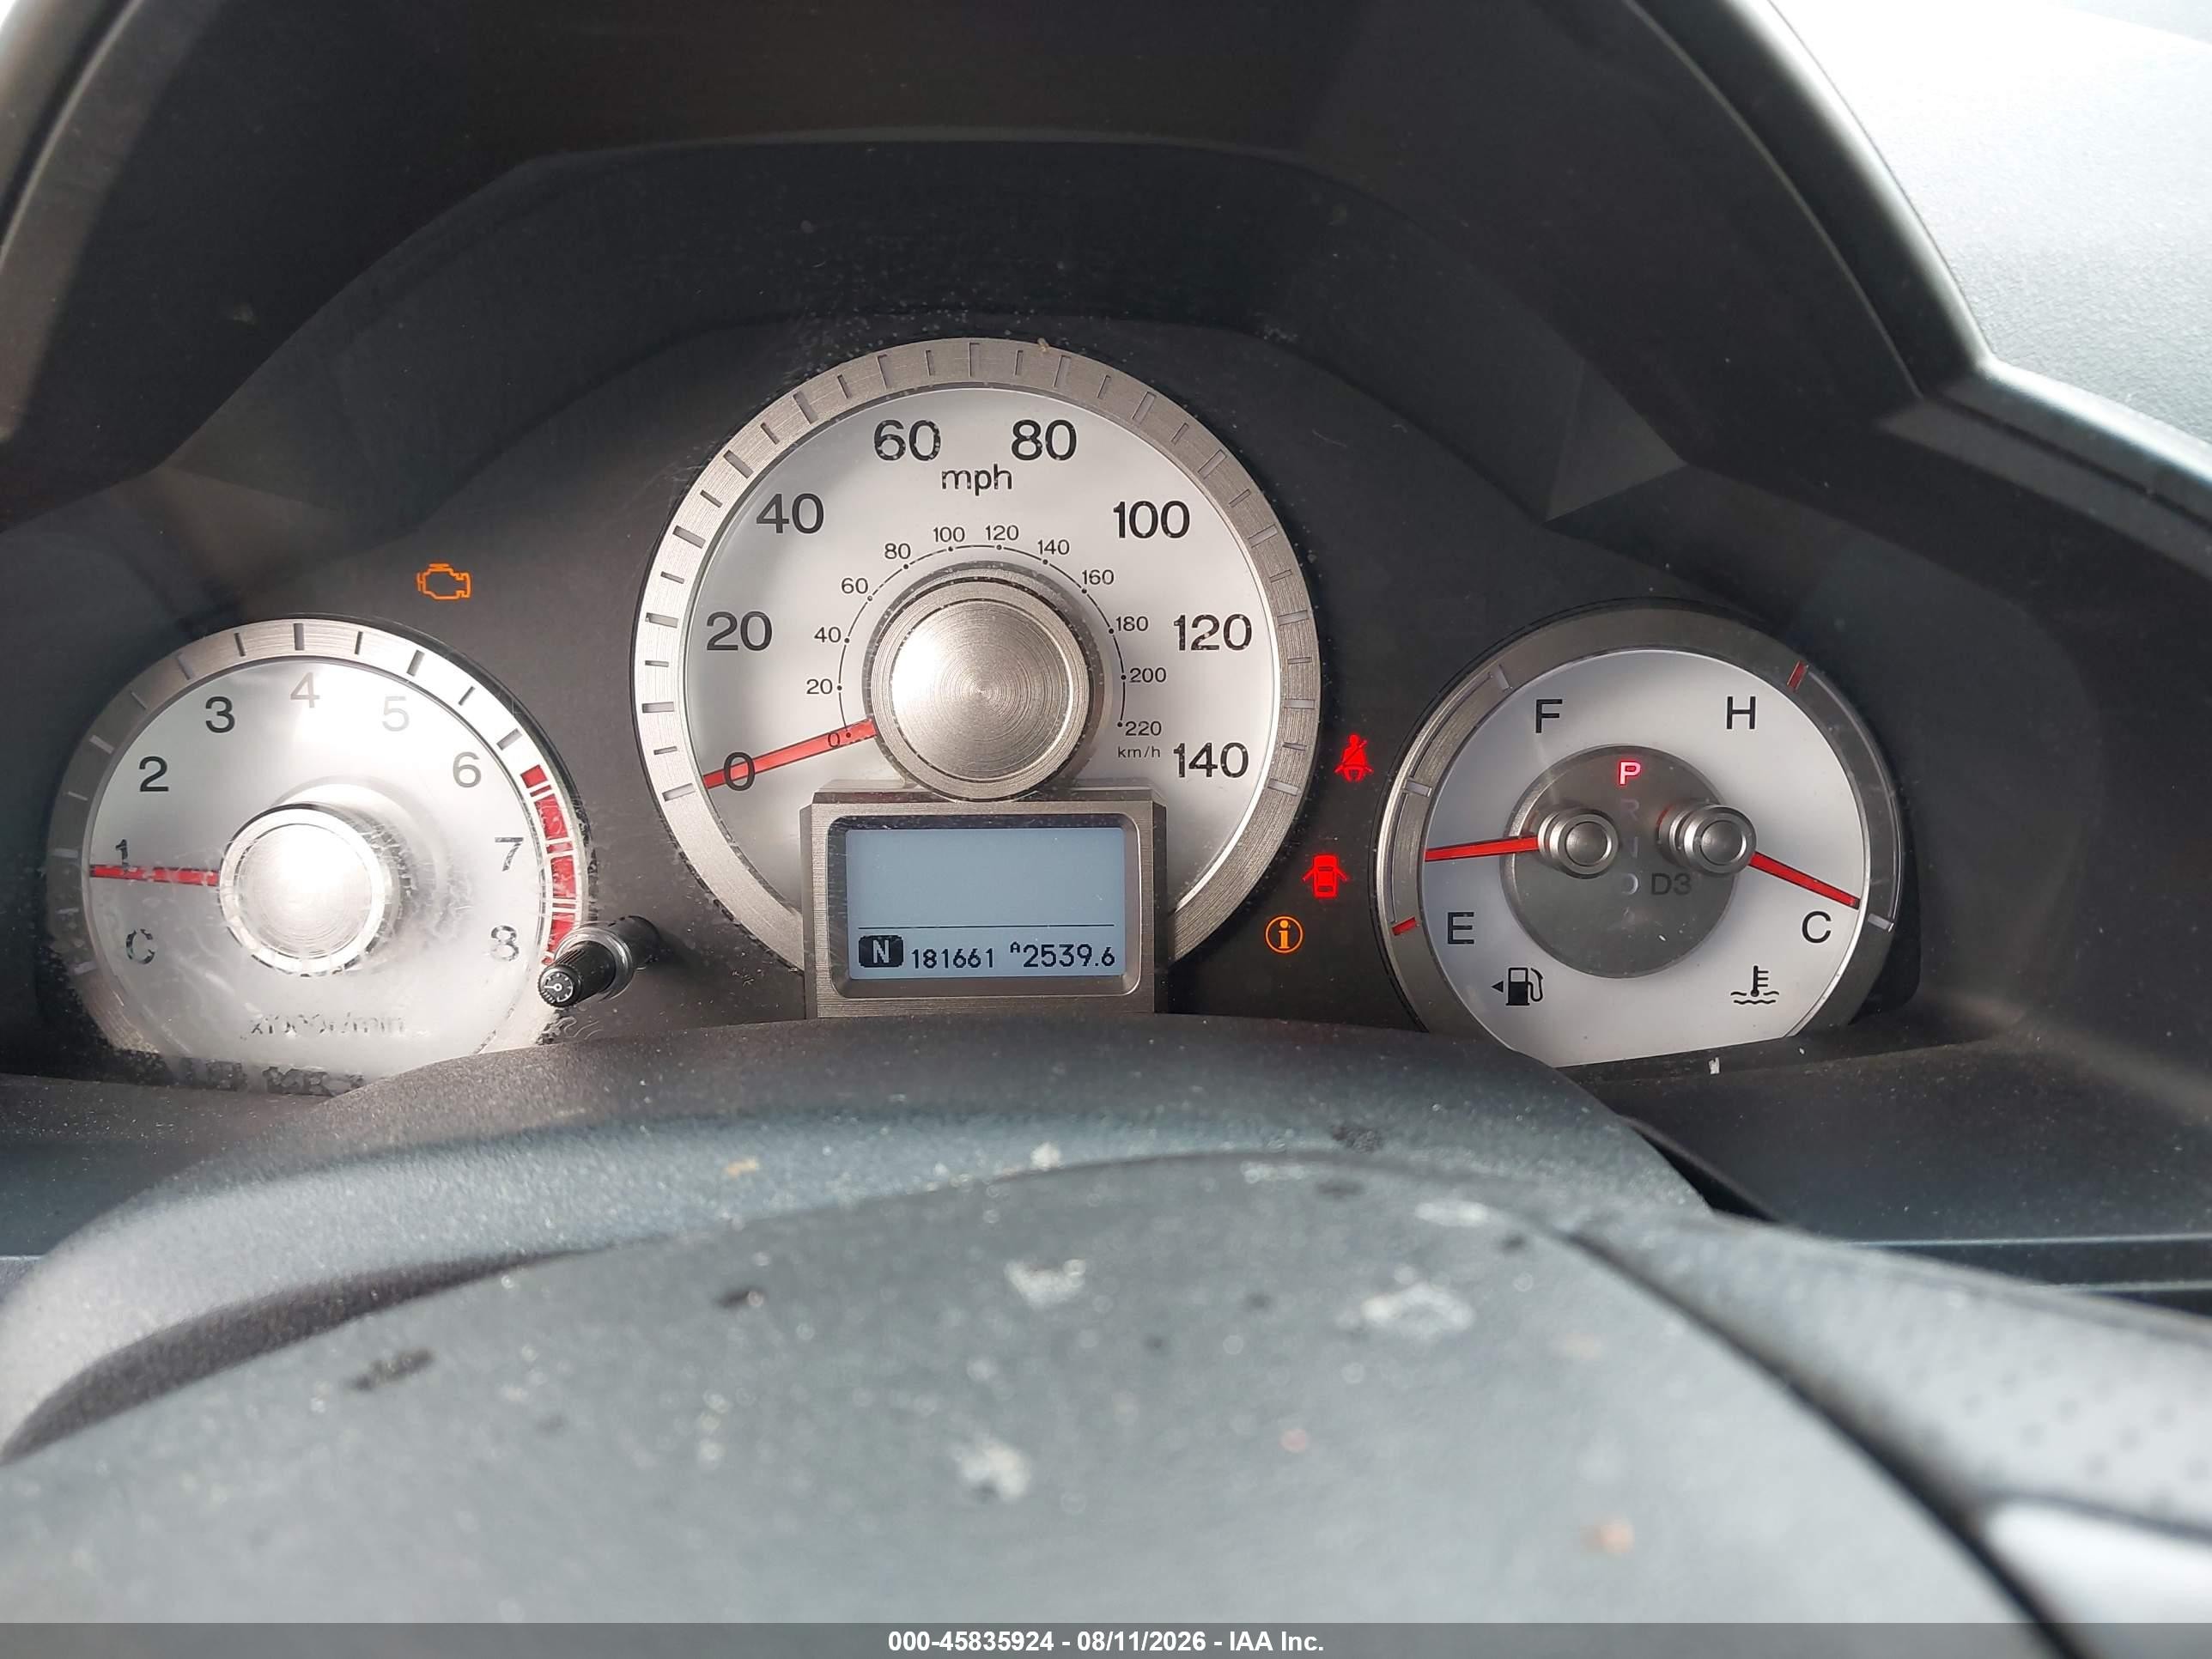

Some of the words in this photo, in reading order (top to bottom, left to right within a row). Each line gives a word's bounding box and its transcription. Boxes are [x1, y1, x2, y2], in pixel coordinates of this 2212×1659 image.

[874, 420, 940, 461] 60
[1012, 420, 1077, 461] 80
[941, 464, 1012, 496] mph
[756, 493, 824, 534] 40
[1113, 501, 1190, 538] 100
[933, 526, 966, 543] 100
[985, 525, 1019, 541] 120
[1037, 539, 1070, 556] 140
[884, 543, 911, 560] 80
[841, 577, 869, 594] 60
[1081, 569, 1115, 586] 160
[706, 611, 773, 652] 20
[814, 626, 842, 643] 40
[1116, 616, 1149, 632] 180
[1173, 614, 1253, 652] 120
[290, 672, 320, 708] 4
[805, 678, 833, 695] 20
[1129, 666, 1167, 684] 200
[204, 696, 235, 733] 3
[381, 696, 410, 732] 5
[1125, 720, 1162, 737] 220
[1535, 698, 1563, 734] F
[1726, 696, 1757, 731] H
[1117, 744, 1161, 759] km/h
[1173, 743, 1249, 779] 140
[138, 756, 169, 793] 2
[453, 751, 482, 788] 6
[723, 751, 756, 792] 0
[1618, 760, 1642, 786] P
[115, 838, 131, 872] 1
[495, 836, 525, 872] 7
[1650, 872, 1692, 896] D3
[490, 925, 520, 962] 8
[1447, 911, 1475, 945] E
[1802, 910, 1832, 944] C
[872, 939, 890, 963] N
[911, 948, 995, 969] 181661
